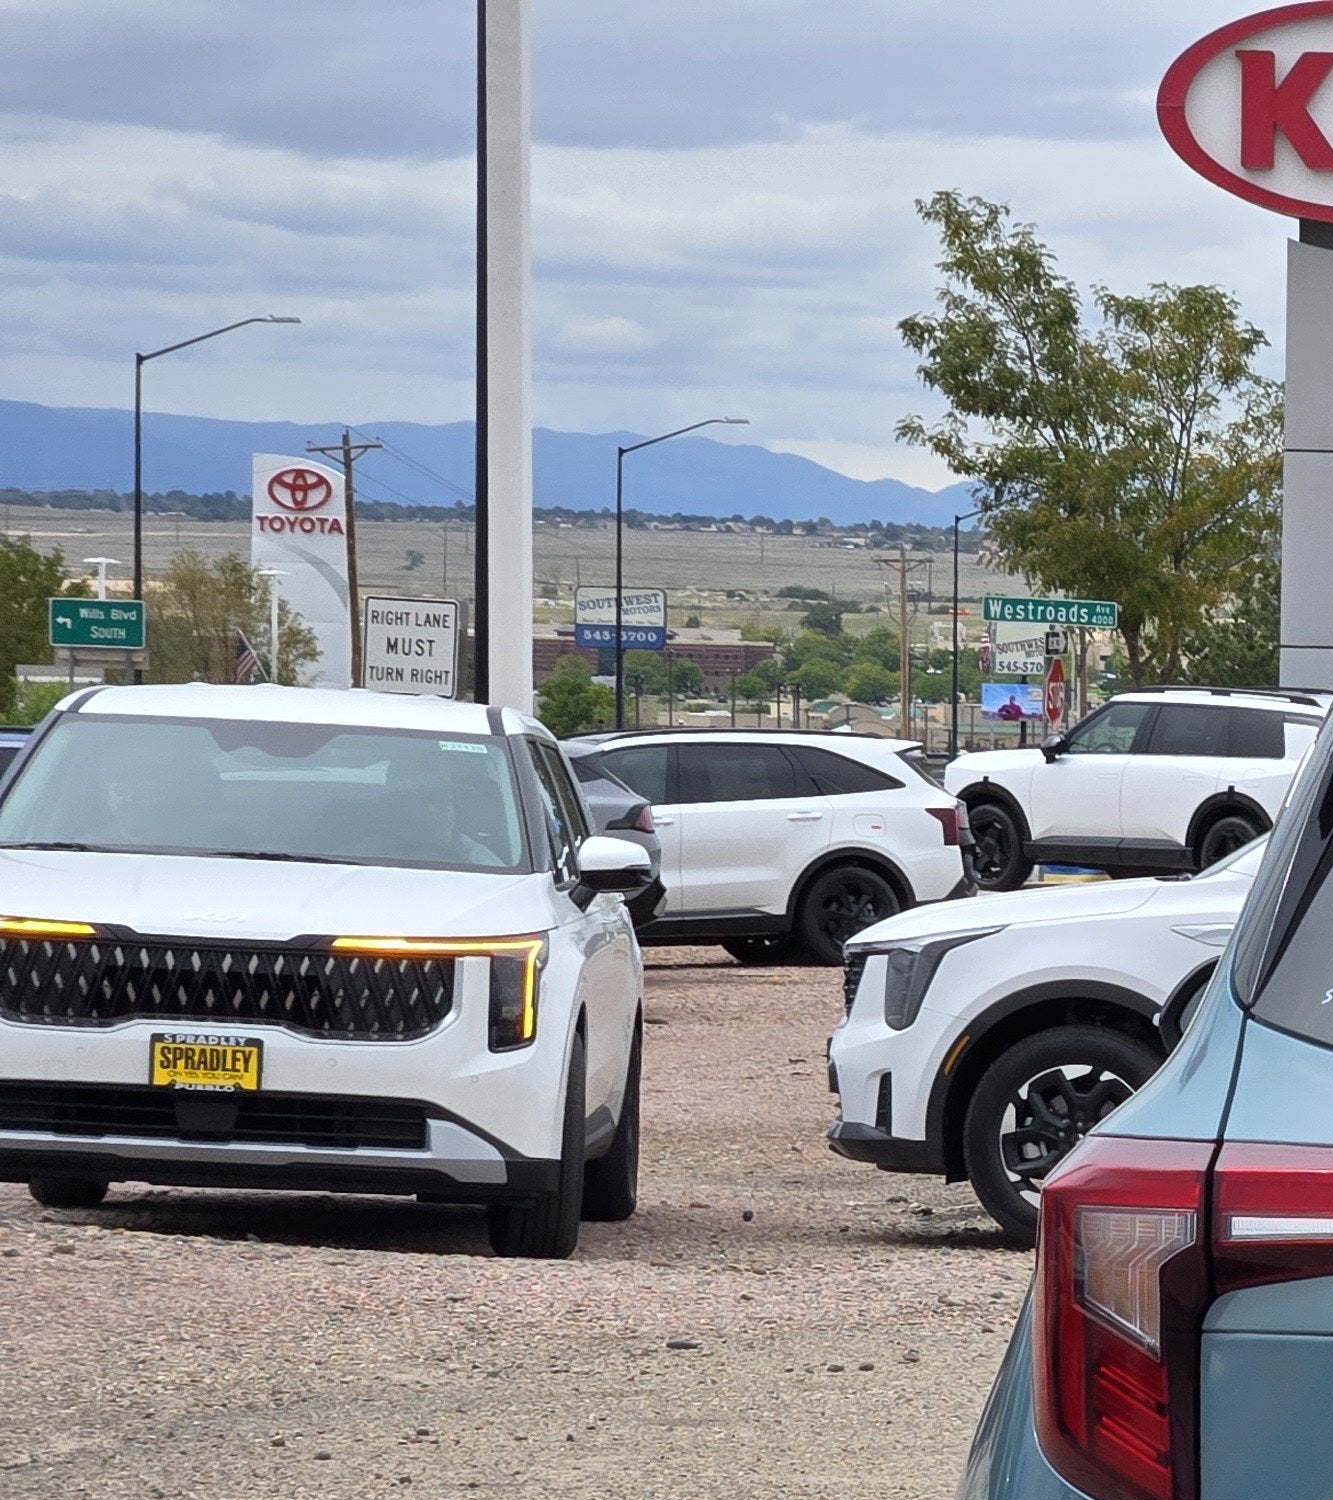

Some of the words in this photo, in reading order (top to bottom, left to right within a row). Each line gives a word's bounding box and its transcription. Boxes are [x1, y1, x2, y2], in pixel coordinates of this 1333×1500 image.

[256, 515, 345, 535] TOYOTA
[111, 608, 137, 621] Blvd
[621, 604, 662, 616] MOTORS
[989, 599, 1089, 624] Westroads
[1095, 603, 1111, 614] Ave
[371, 609, 411, 627] RIGHT
[415, 611, 451, 629] LANE
[1091, 614, 1114, 625] 4000
[386, 636, 436, 657] MUST
[998, 660, 1043, 672] 545-570
[369, 665, 405, 683] TURN
[410, 668, 451, 686] RIGHT
[163, 1033, 247, 1046] SPRADLEY
[160, 1046, 254, 1073] SPRADLEY
[174, 1082, 235, 1092] PUEBLO
